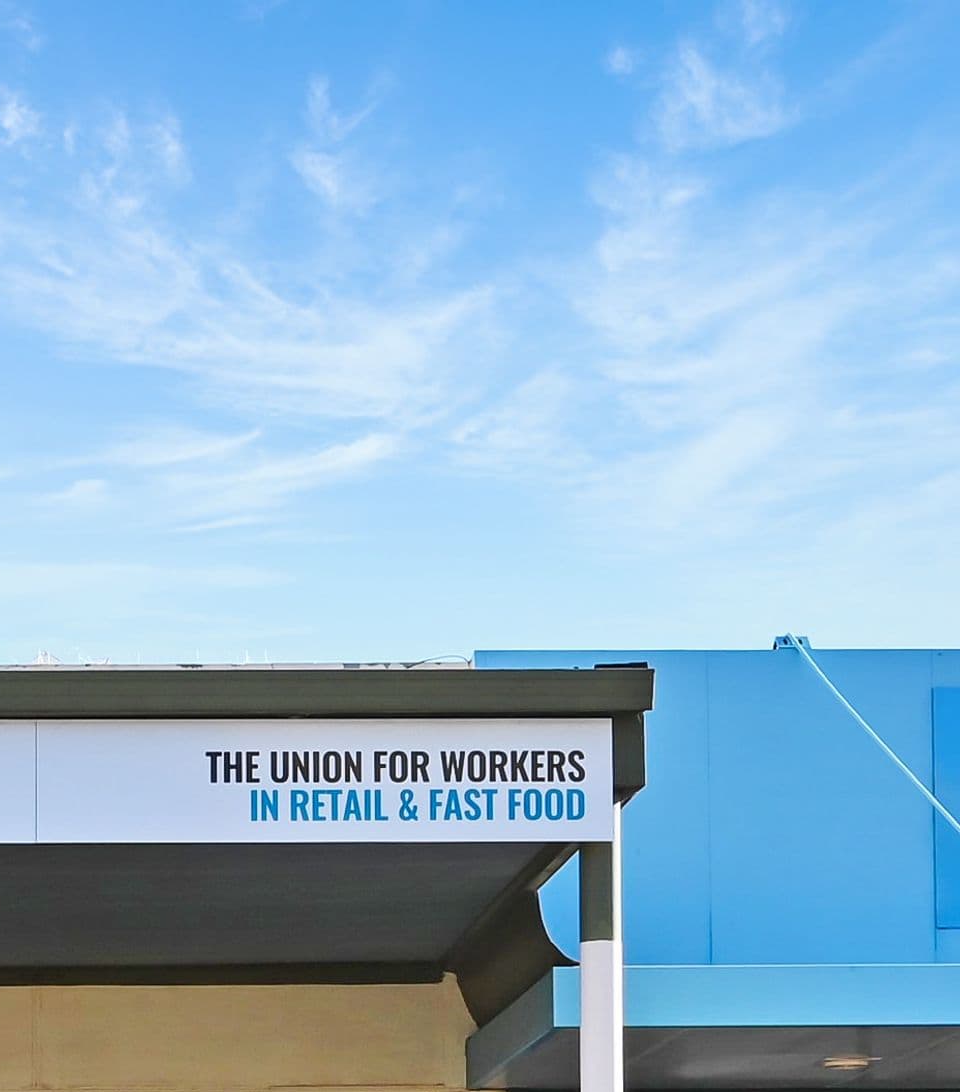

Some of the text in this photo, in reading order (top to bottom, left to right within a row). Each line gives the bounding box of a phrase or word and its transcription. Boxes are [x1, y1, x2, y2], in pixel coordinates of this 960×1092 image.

[205, 750, 586, 783] THE UNION FOR WORKERS
[250, 789, 585, 821] IN RETAIL & FAST FOOD
